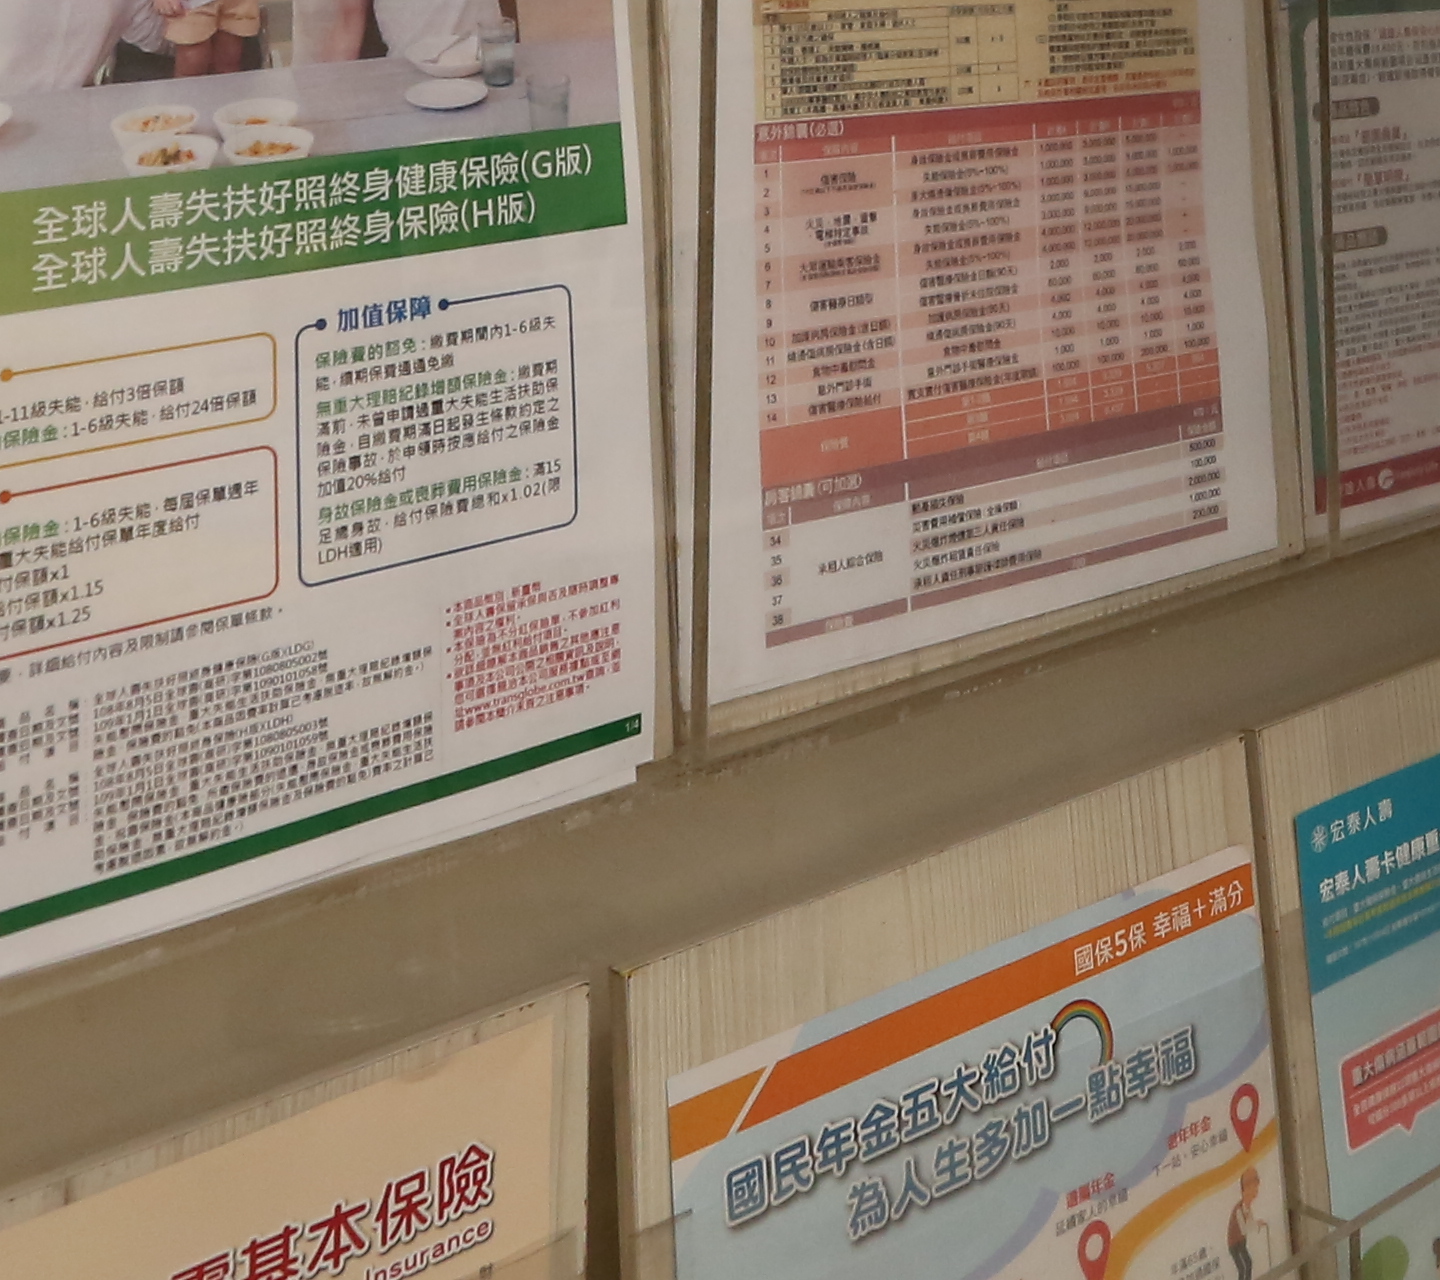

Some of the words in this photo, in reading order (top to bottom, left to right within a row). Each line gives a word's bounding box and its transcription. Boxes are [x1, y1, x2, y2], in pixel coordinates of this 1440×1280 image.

[32, 143, 593, 246] 全球人壽失扶好照終身健康保險(G版)
[32, 190, 537, 293] 全球人壽失扶好照終身保險(H版)
[336, 295, 432, 333] 加值保障
[1329, 797, 1393, 845] 宏泰人壽
[1073, 921, 1147, 977] 國保5保
[724, 1026, 1057, 1229] 國民年金五大給付
[847, 1024, 1198, 1244] 為人生多加一點幸福
[364, 1219, 491, 1280] Insurance
